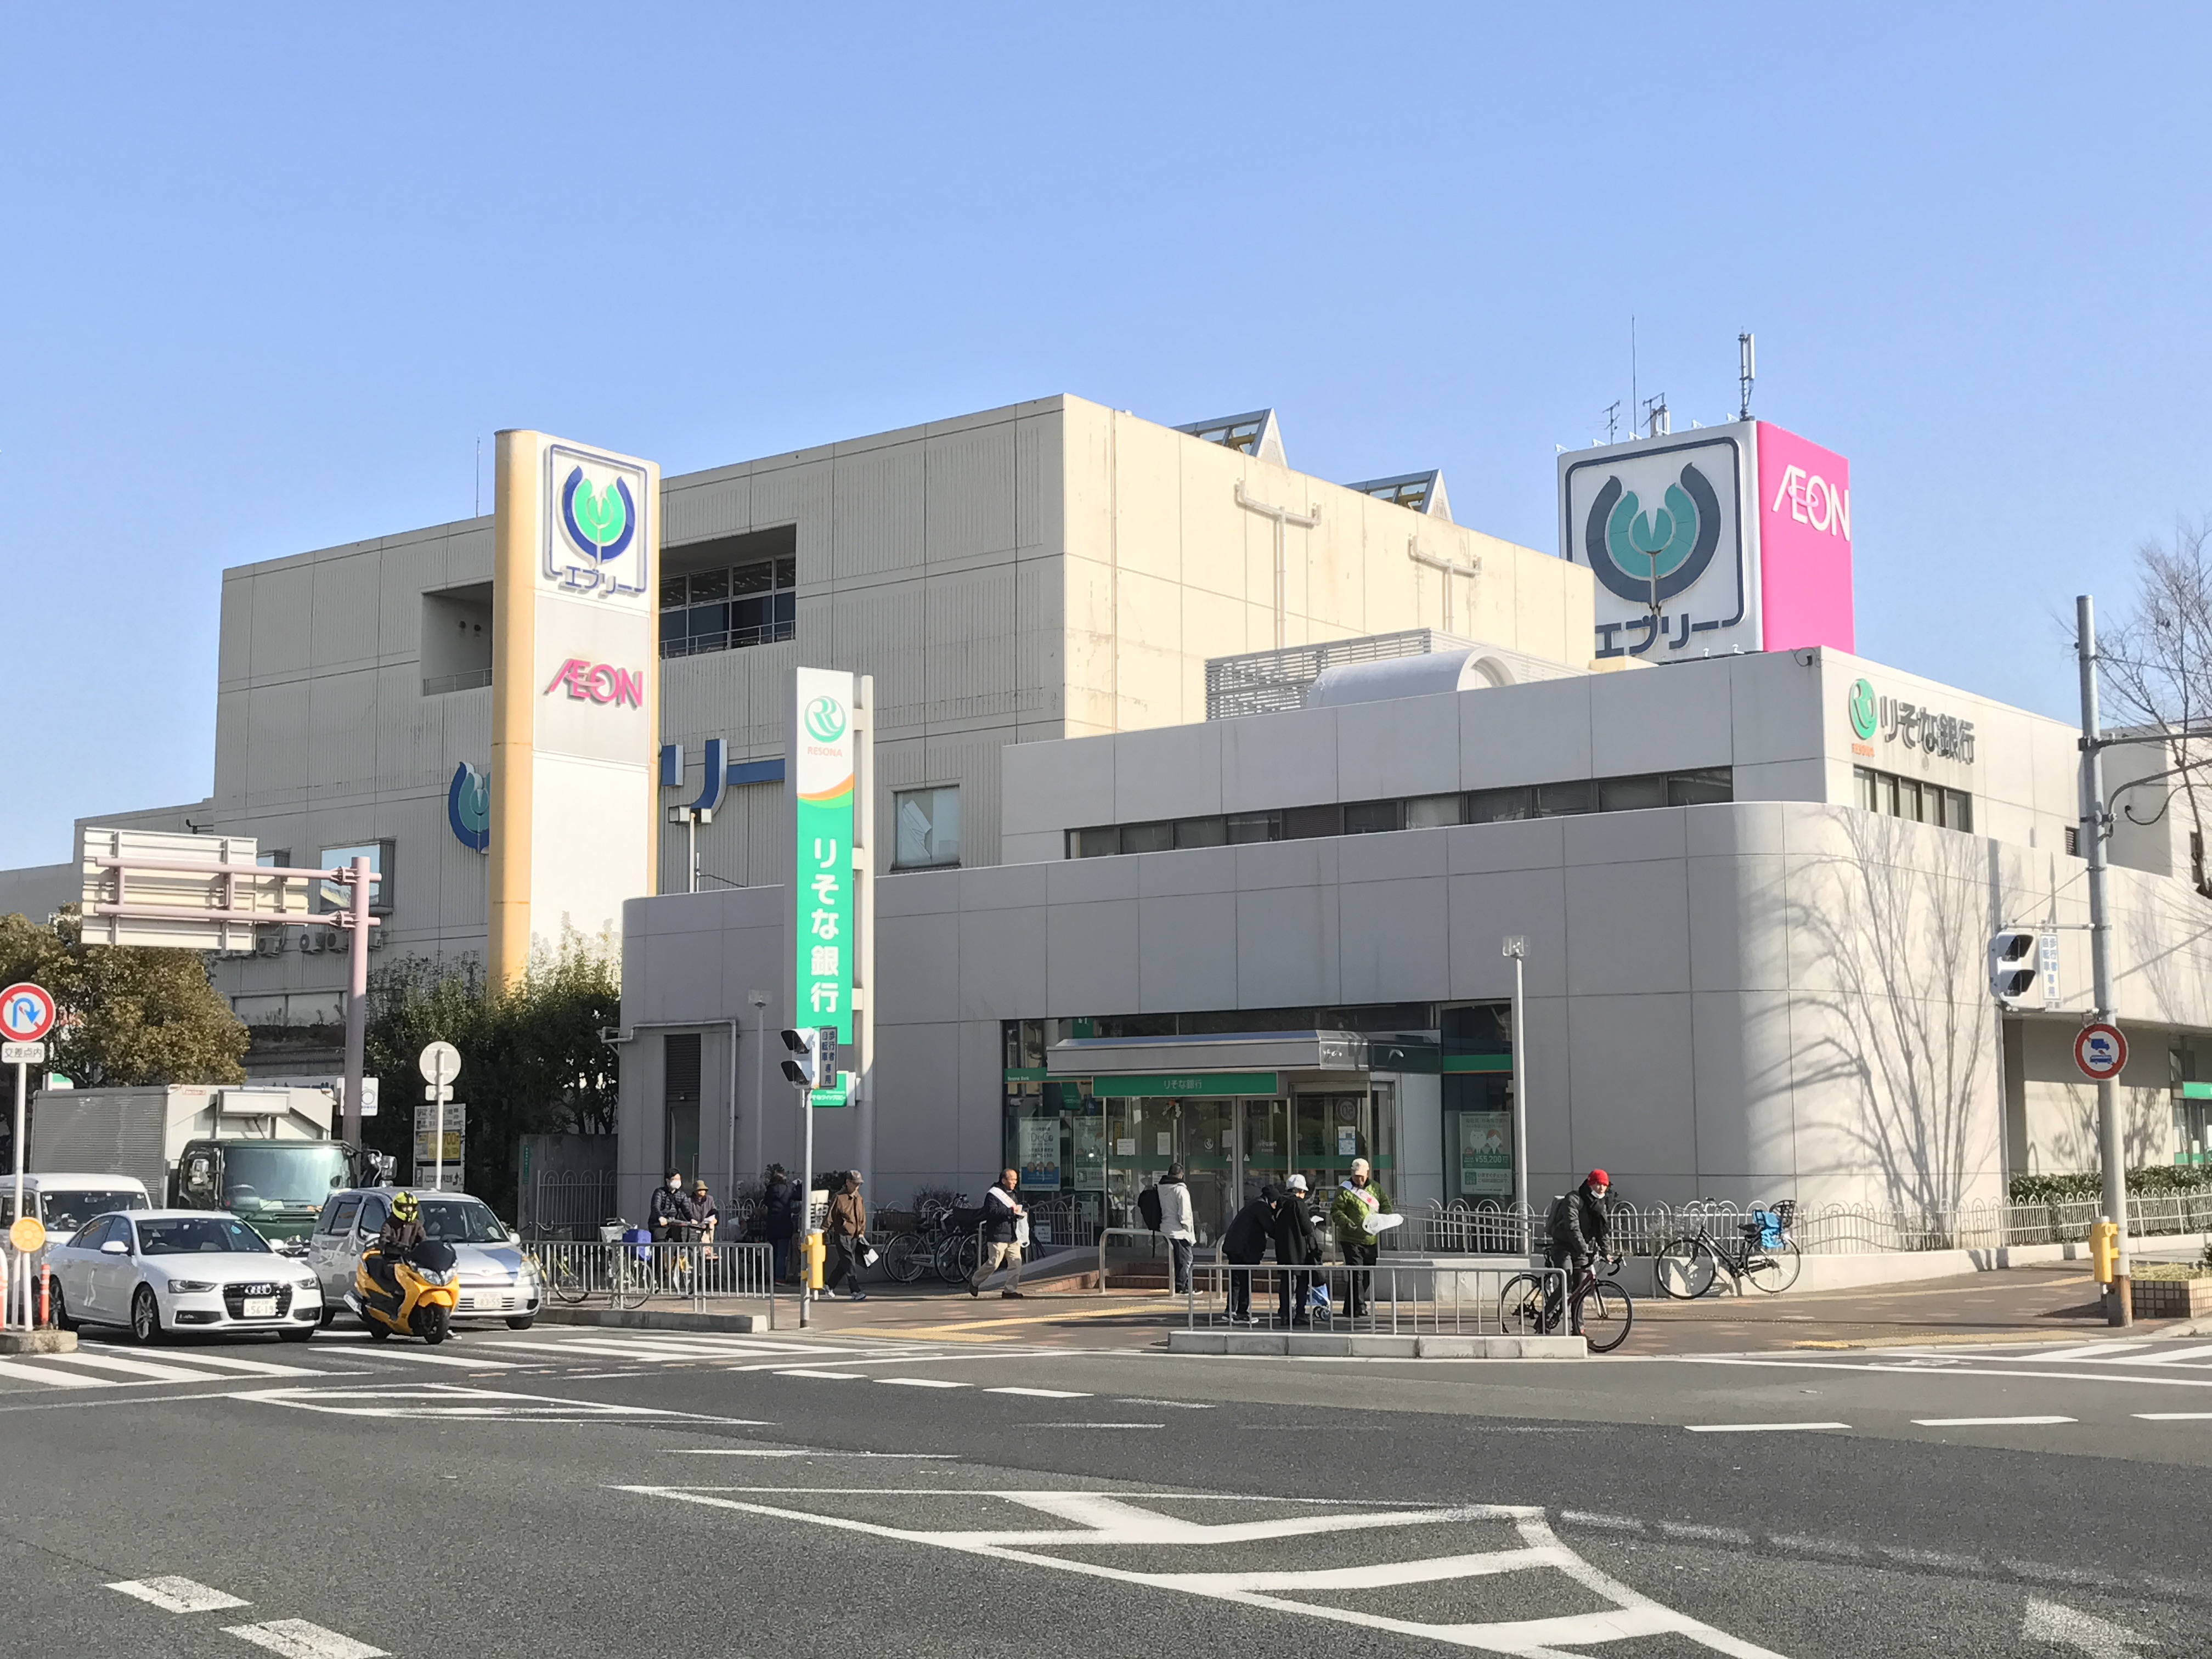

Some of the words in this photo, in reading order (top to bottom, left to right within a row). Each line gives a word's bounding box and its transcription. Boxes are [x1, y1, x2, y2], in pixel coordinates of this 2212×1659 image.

[565, 565, 633, 595] エブリー
[1595, 613, 1719, 657] エブリー
[1880, 696, 1976, 765] りそな銀行
[807, 746, 843, 757] RESONA
[810, 837, 839, 1013] りそな銀行
[4, 1047, 42, 1058] 交差点内
[825, 1064, 831, 1084] 専用
[1163, 1079, 1203, 1090] りそな銀行
[1028, 1132, 1054, 1142] iDeCo
